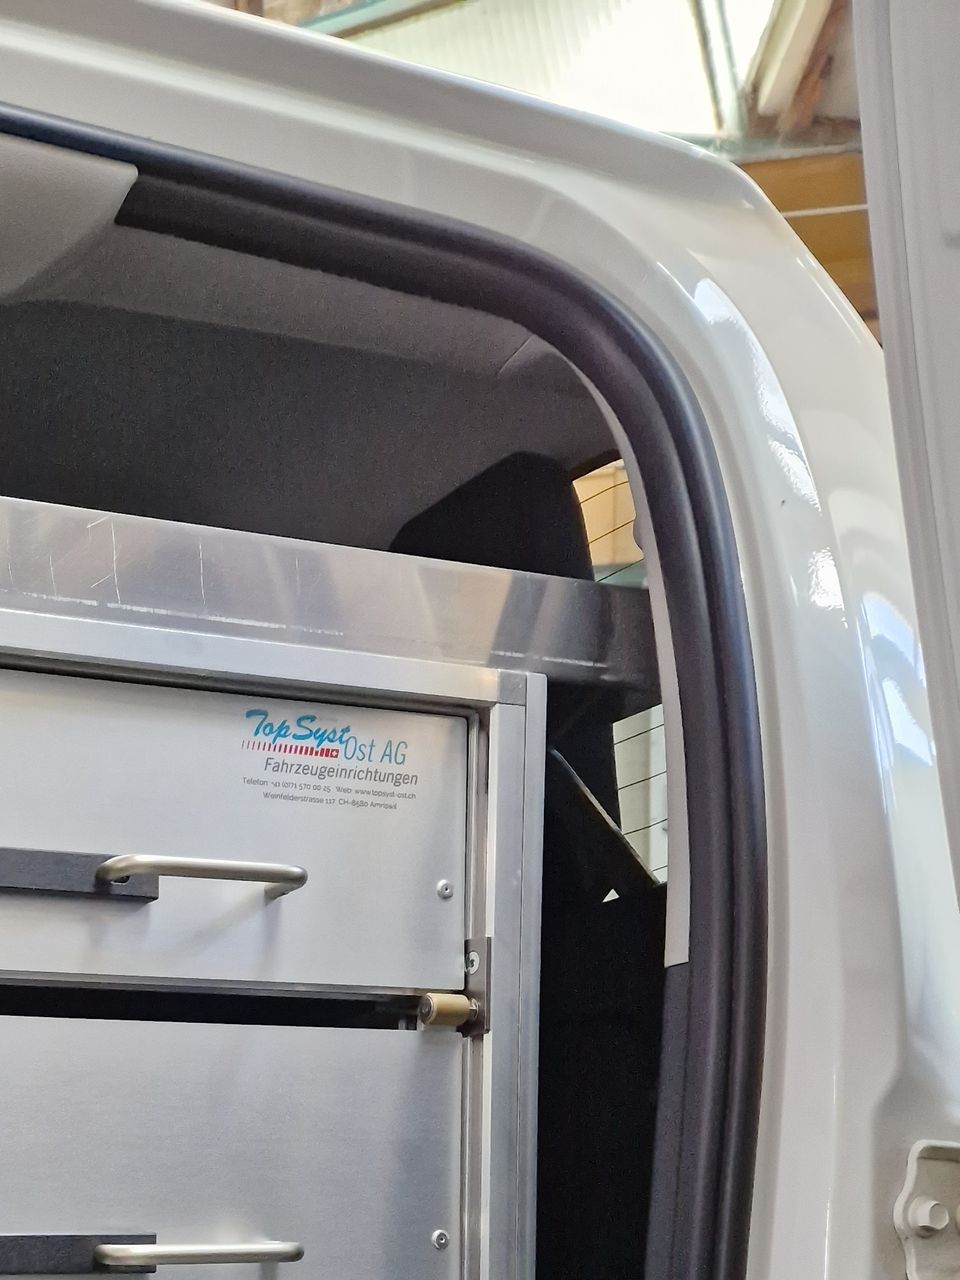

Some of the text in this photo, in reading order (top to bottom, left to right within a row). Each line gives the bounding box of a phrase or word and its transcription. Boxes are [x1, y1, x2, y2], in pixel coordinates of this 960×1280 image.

[344, 735, 375, 763] Ost
[380, 739, 408, 765] AG
[243, 777, 268, 786] Telefon
[299, 783, 311, 791] 570
[264, 757, 418, 787] Fahrzeugeinrichtungen
